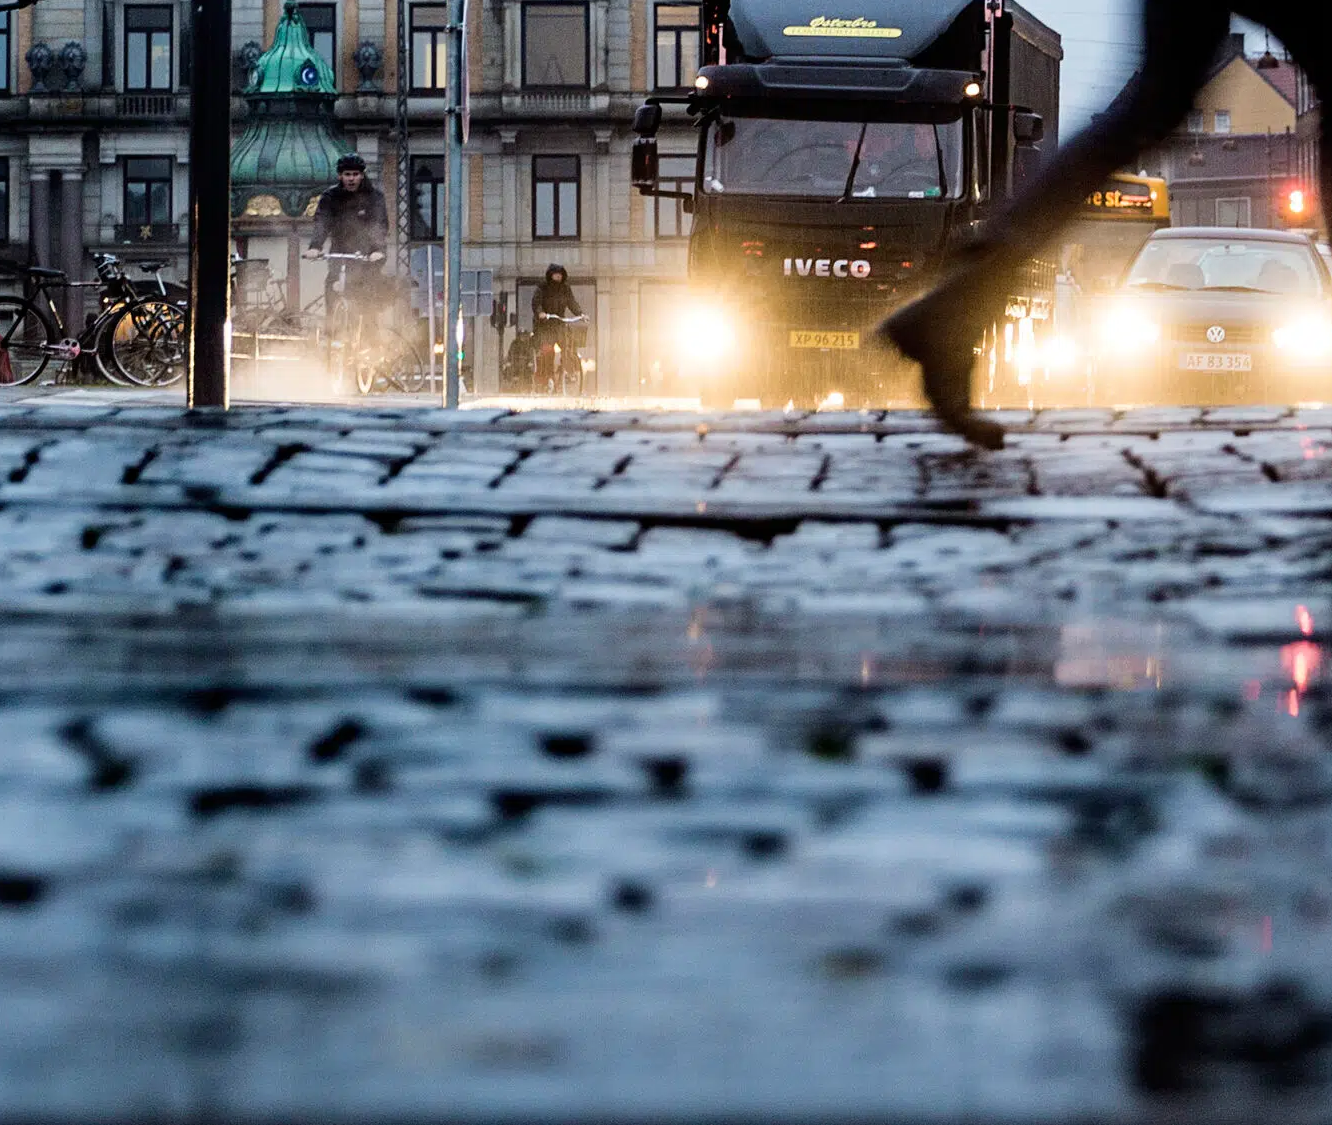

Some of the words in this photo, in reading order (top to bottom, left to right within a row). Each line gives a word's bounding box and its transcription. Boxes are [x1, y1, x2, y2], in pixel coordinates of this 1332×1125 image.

[809, 15, 877, 28] Østerbro
[783, 258, 871, 278] IVECO
[795, 335, 812, 346] XP
[814, 335, 830, 347] 96
[832, 335, 855, 348] 215
[1187, 356, 1204, 367] AF
[1207, 356, 1223, 368] 83
